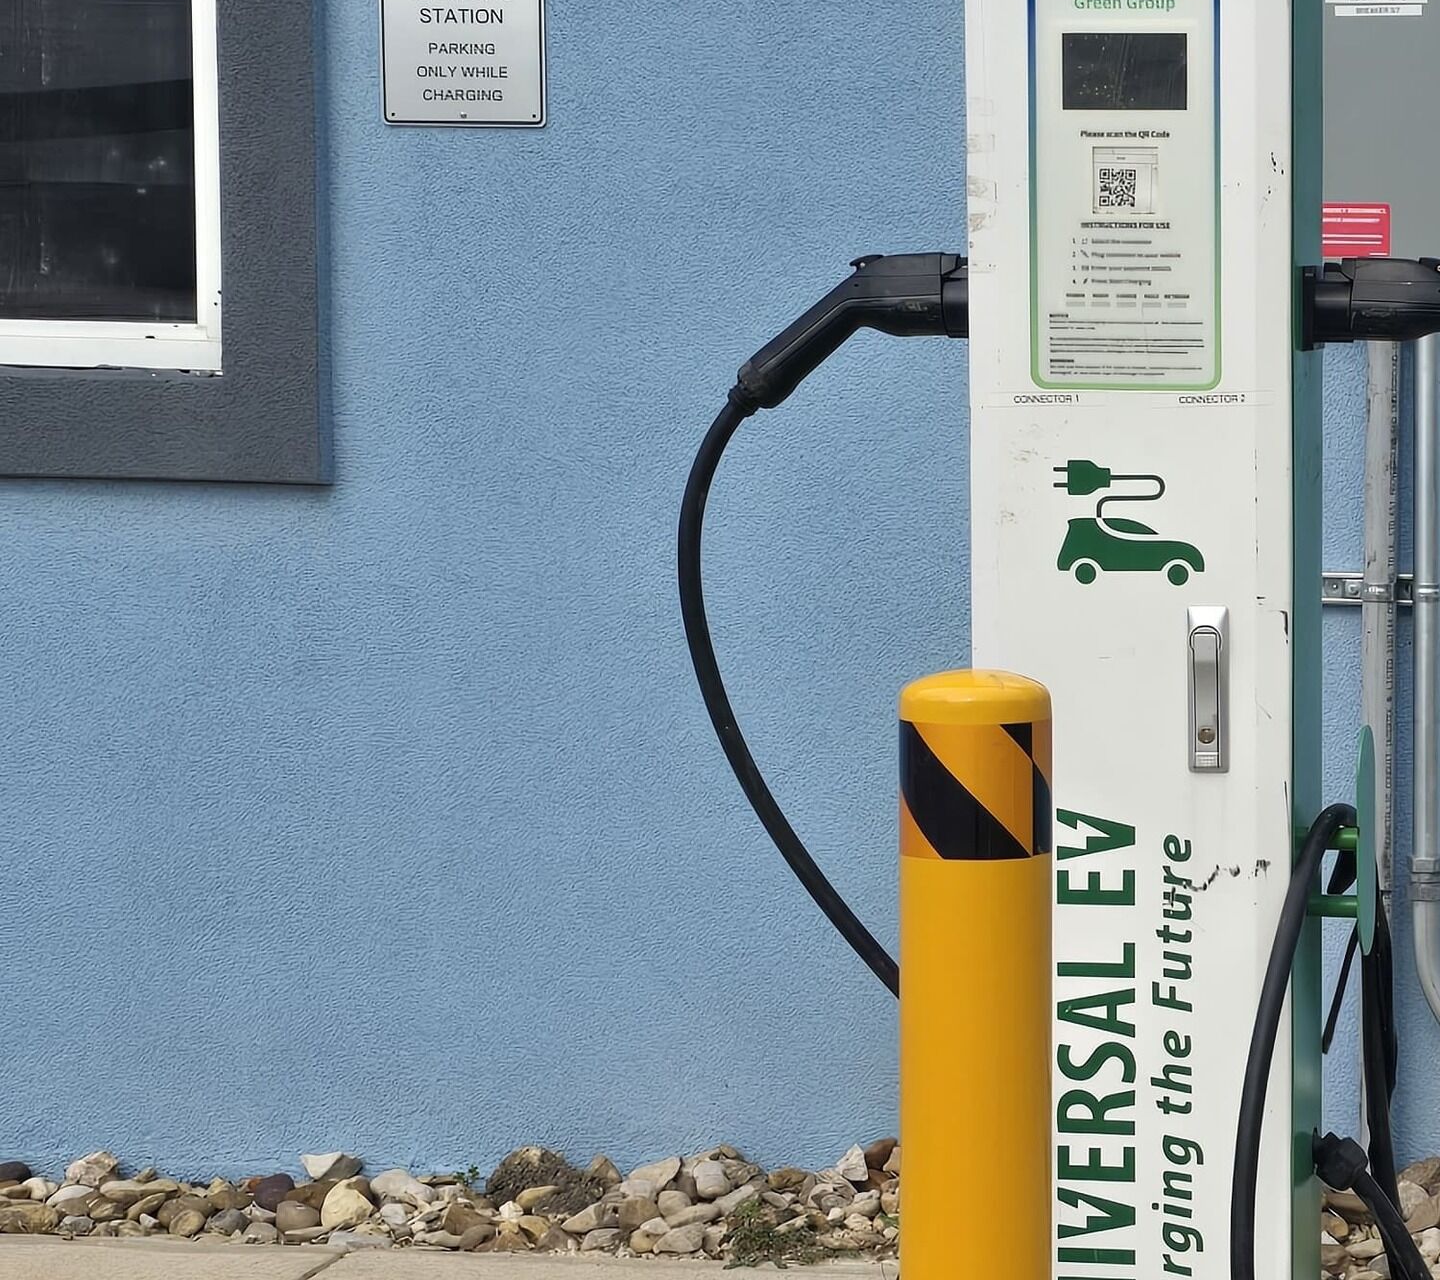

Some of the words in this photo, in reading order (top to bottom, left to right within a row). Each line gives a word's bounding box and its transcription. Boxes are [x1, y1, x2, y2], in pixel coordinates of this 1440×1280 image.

[420, 8, 502, 23] STATION
[429, 43, 495, 54] PARKING
[417, 66, 456, 77] ONLY
[461, 67, 507, 78] WHILE
[423, 89, 502, 101] CHARGING
[1013, 394, 1073, 404] CONNECTOR
[1178, 394, 1239, 404] CONNECTOR
[1056, 808, 1135, 906] EV
[1152, 835, 1196, 1012] Future
[1151, 1031, 1192, 1114] the
